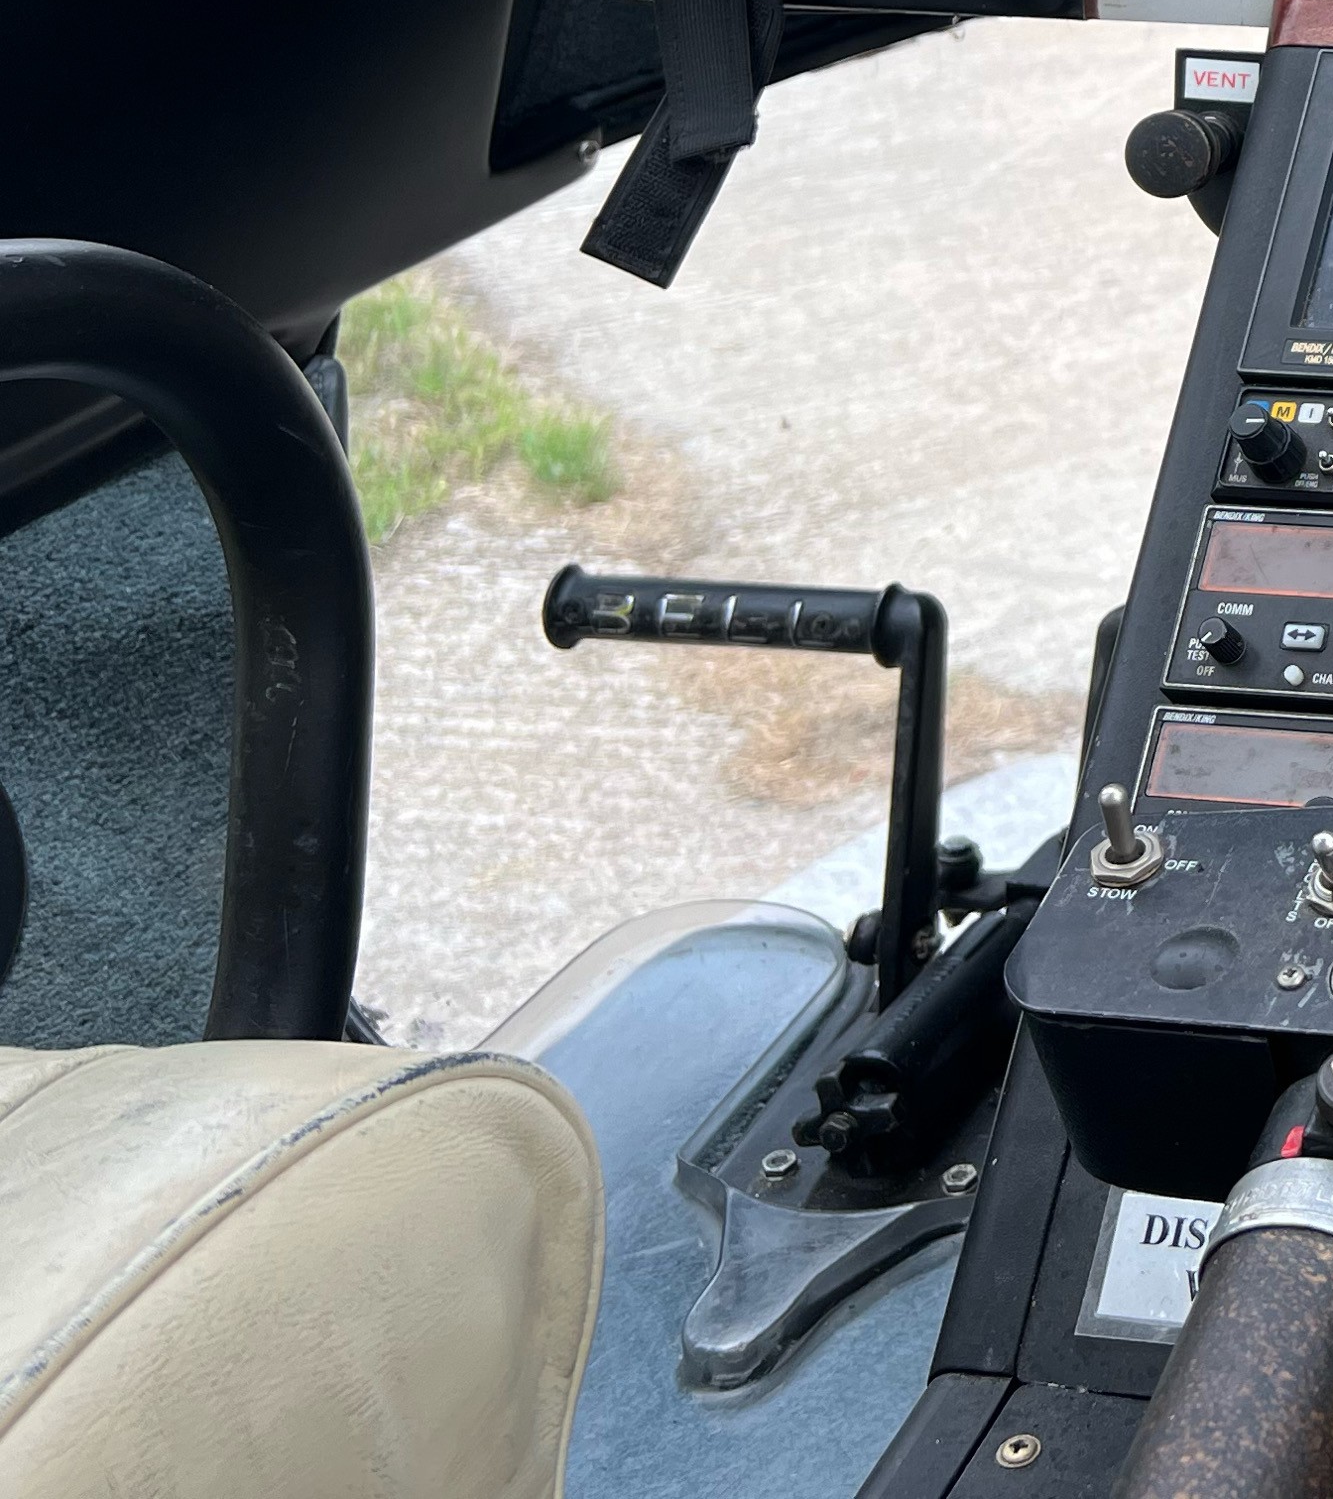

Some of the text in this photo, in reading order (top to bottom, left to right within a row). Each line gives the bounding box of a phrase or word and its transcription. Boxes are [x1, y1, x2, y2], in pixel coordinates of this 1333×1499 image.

[1192, 68, 1252, 90] VENT
[1216, 604, 1252, 616] COMM
[1087, 886, 1136, 901] STOW
